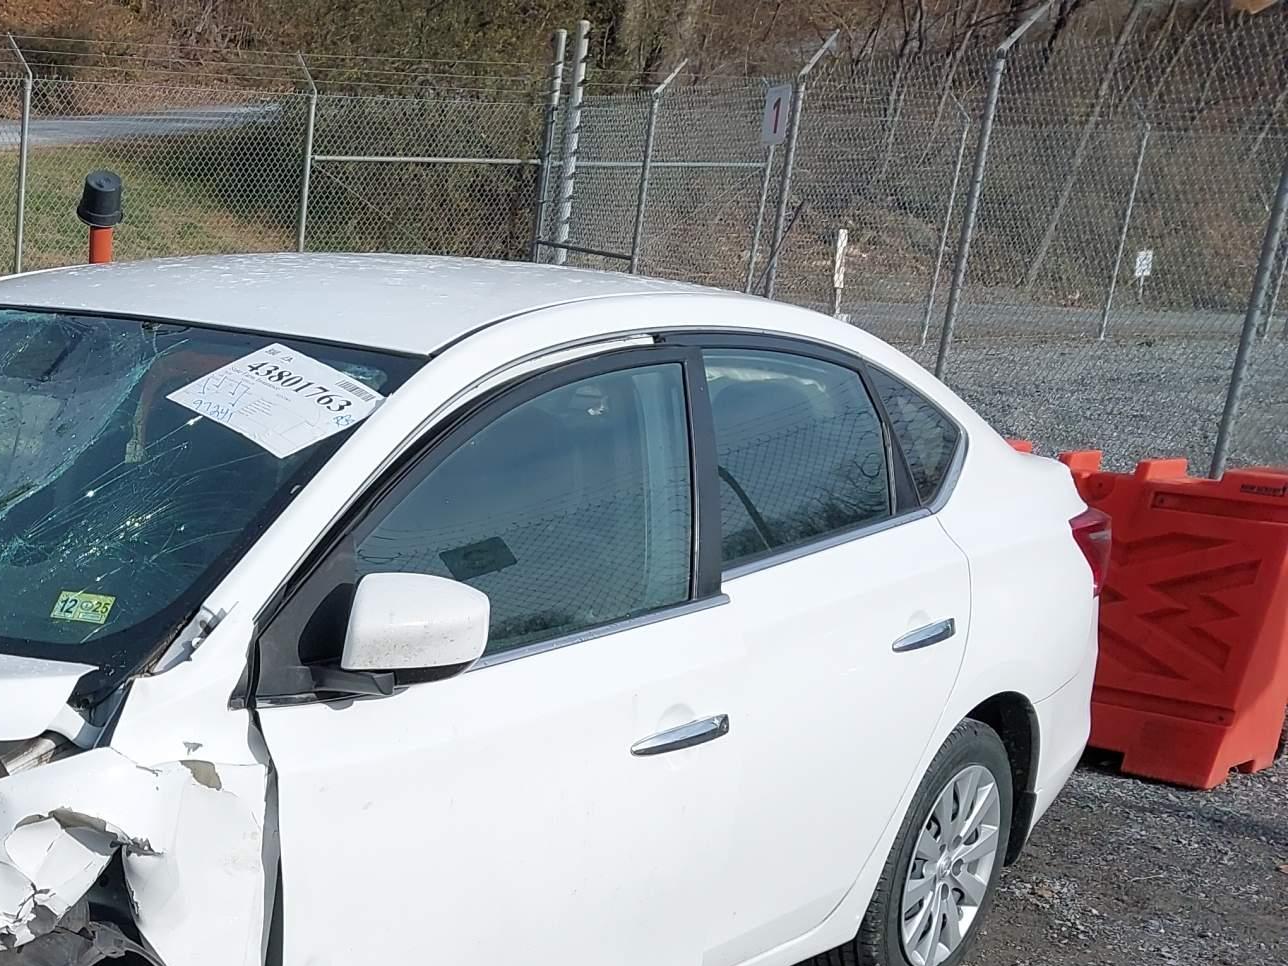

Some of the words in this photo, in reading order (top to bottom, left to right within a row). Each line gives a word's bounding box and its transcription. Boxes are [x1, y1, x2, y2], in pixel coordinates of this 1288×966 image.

[773, 97, 782, 134] 1
[247, 361, 353, 412] 43801763
[60, 597, 78, 614] 12
[92, 601, 111, 614] 25
